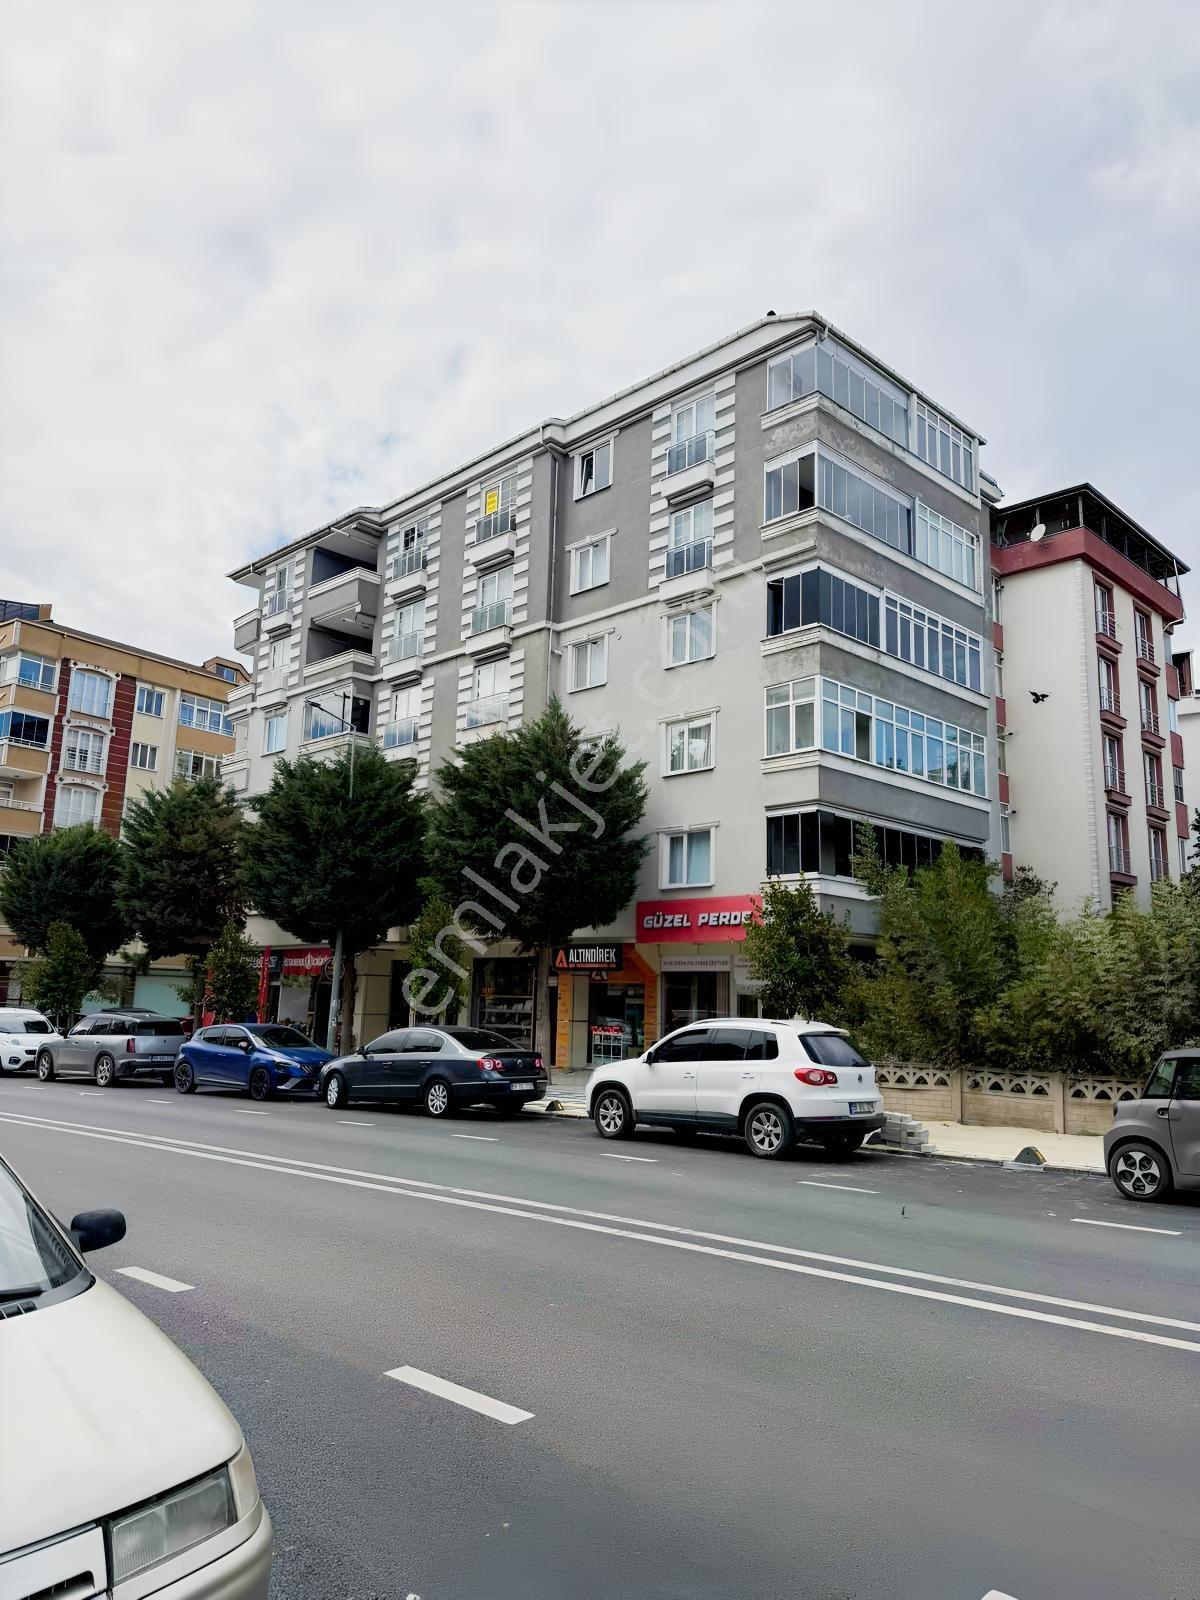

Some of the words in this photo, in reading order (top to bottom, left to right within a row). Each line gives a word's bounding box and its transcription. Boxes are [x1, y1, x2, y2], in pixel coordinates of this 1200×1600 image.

[643, 912, 691, 929] GÜZEL
[698, 910, 752, 927] PERDE
[568, 946, 616, 963] ALTINDİREK
